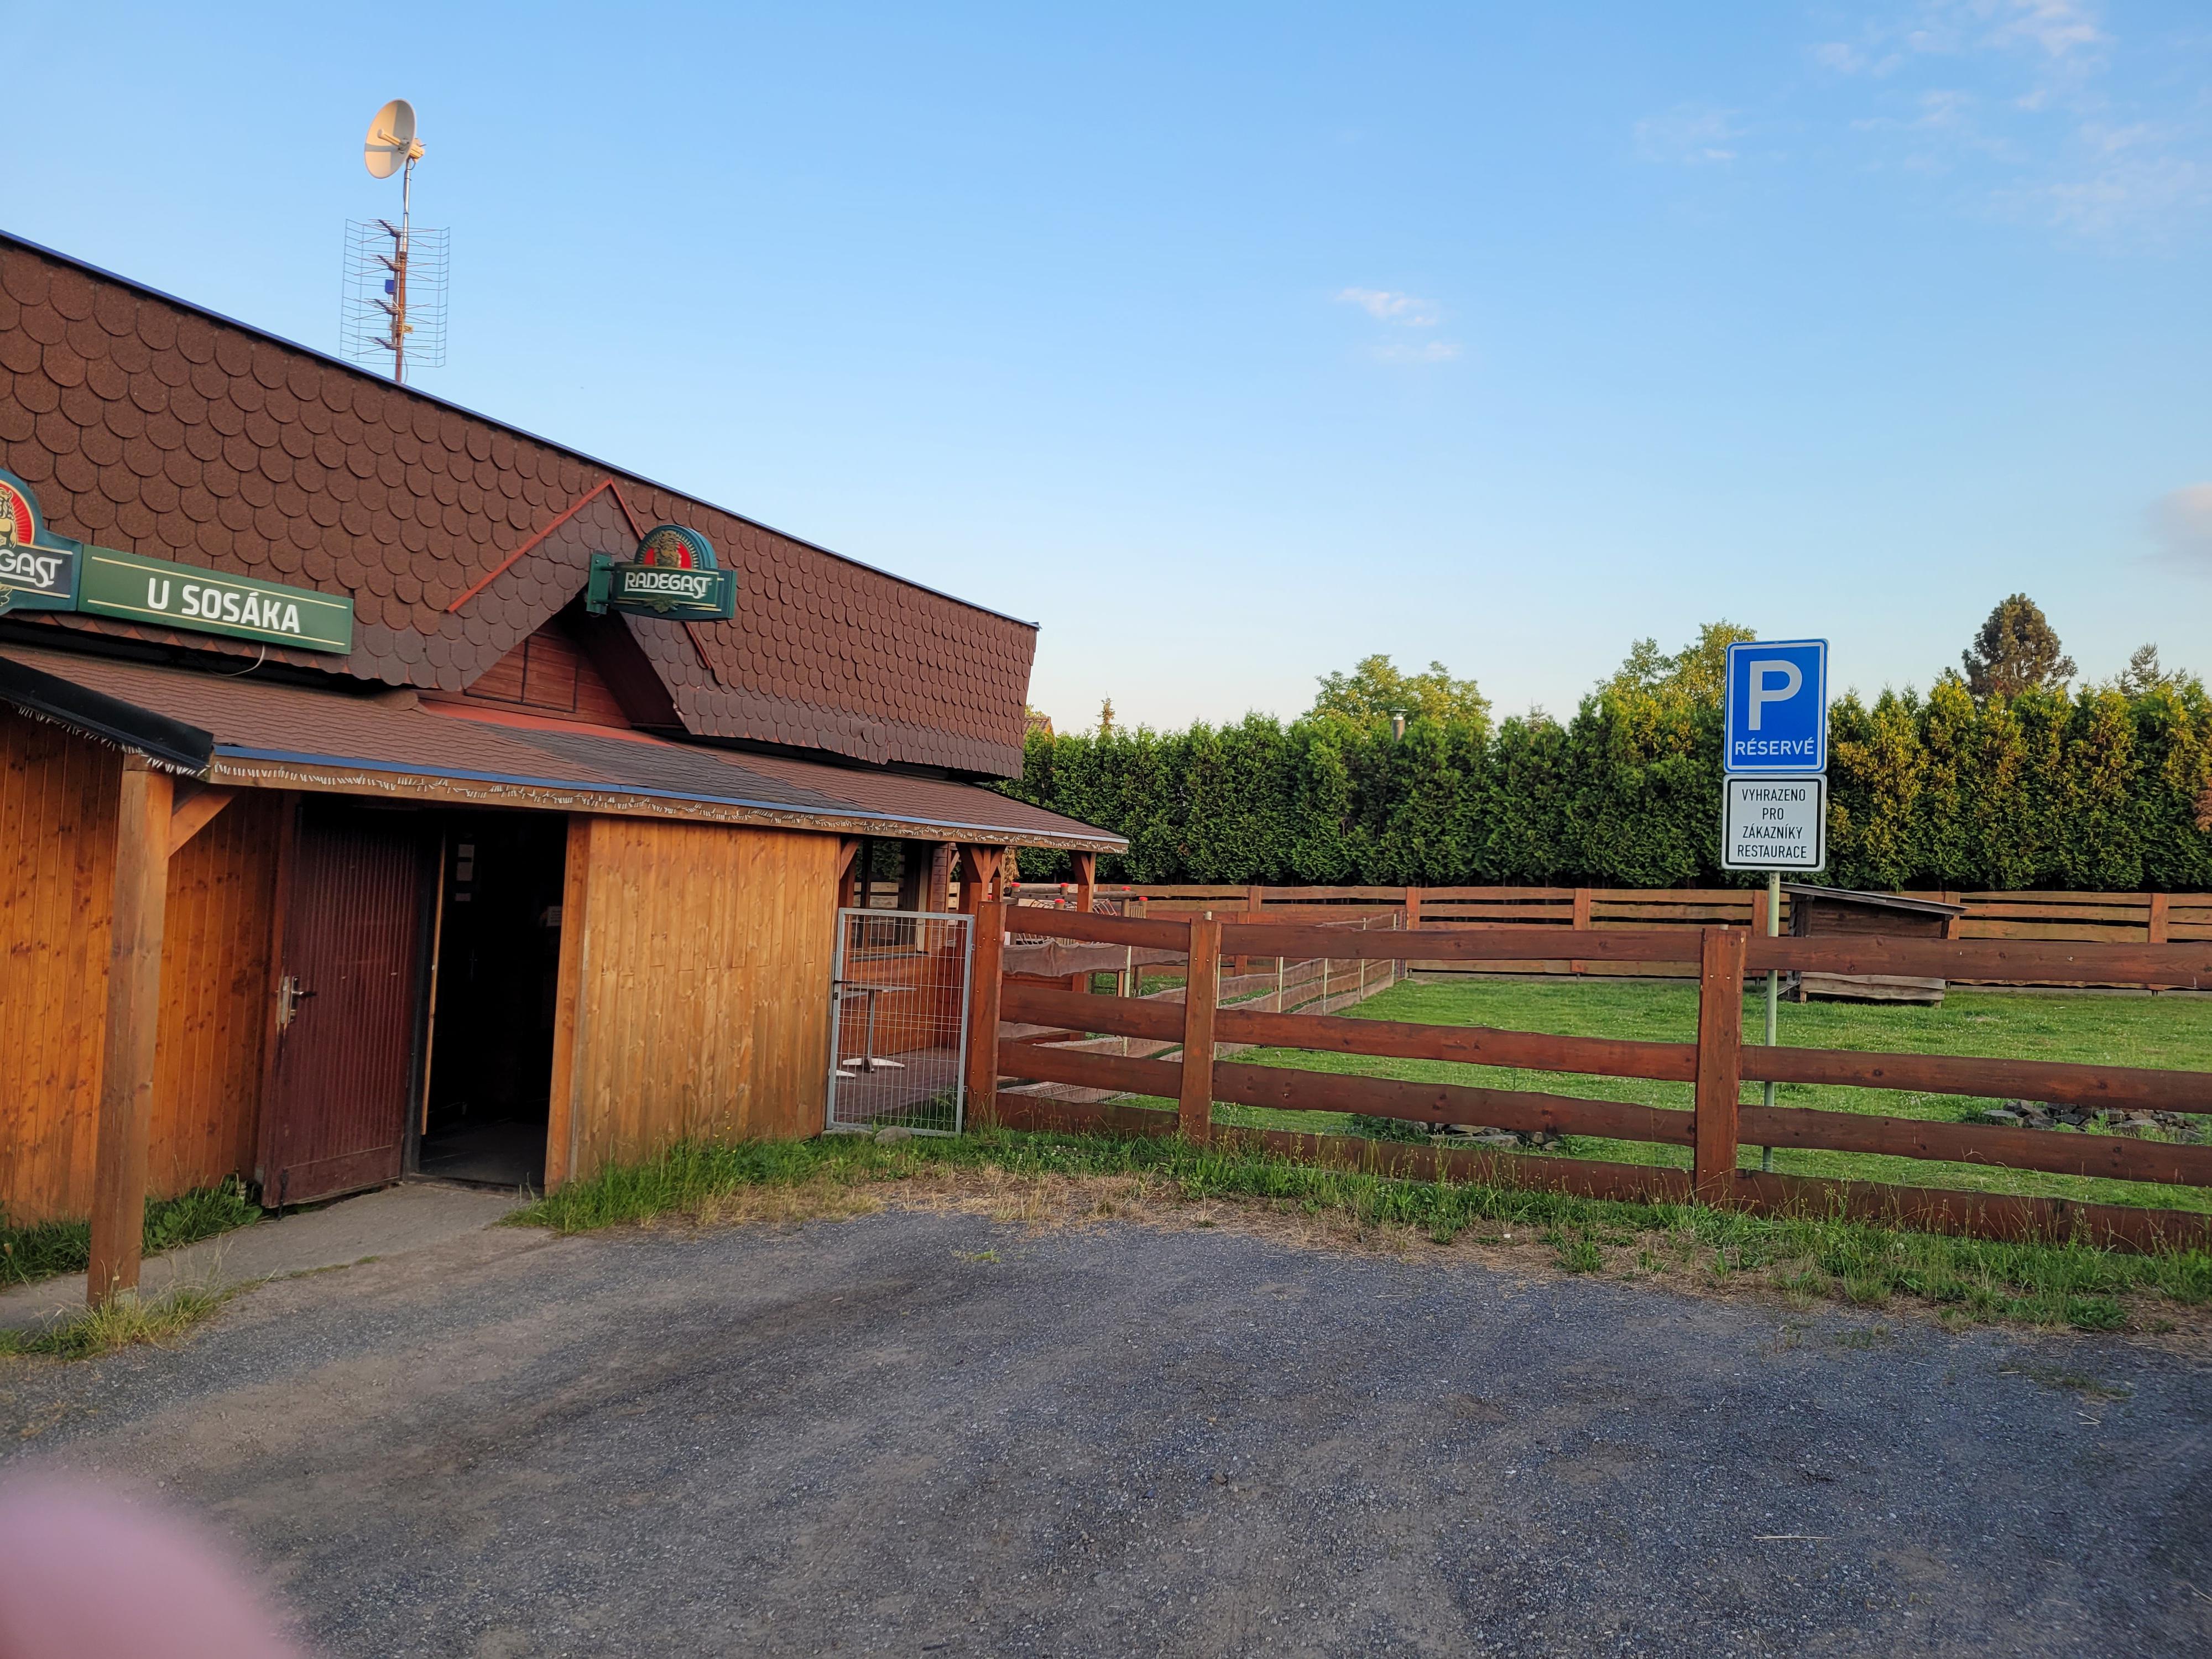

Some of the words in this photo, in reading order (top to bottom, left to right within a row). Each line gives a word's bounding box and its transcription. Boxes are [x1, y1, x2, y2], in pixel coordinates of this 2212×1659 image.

[624, 571, 711, 599] RADEGAST
[147, 577, 170, 610] U
[181, 586, 301, 633] SOSÁKA
[1748, 660, 1803, 731] P
[1734, 737, 1814, 756] RÉSERVÉ
[1741, 788, 1806, 802] VYHRAZENO
[1762, 807, 1784, 820] PRO
[1743, 823, 1803, 839] ZÁKAZNÍKY
[1737, 844, 1807, 859] RESTAURACE
